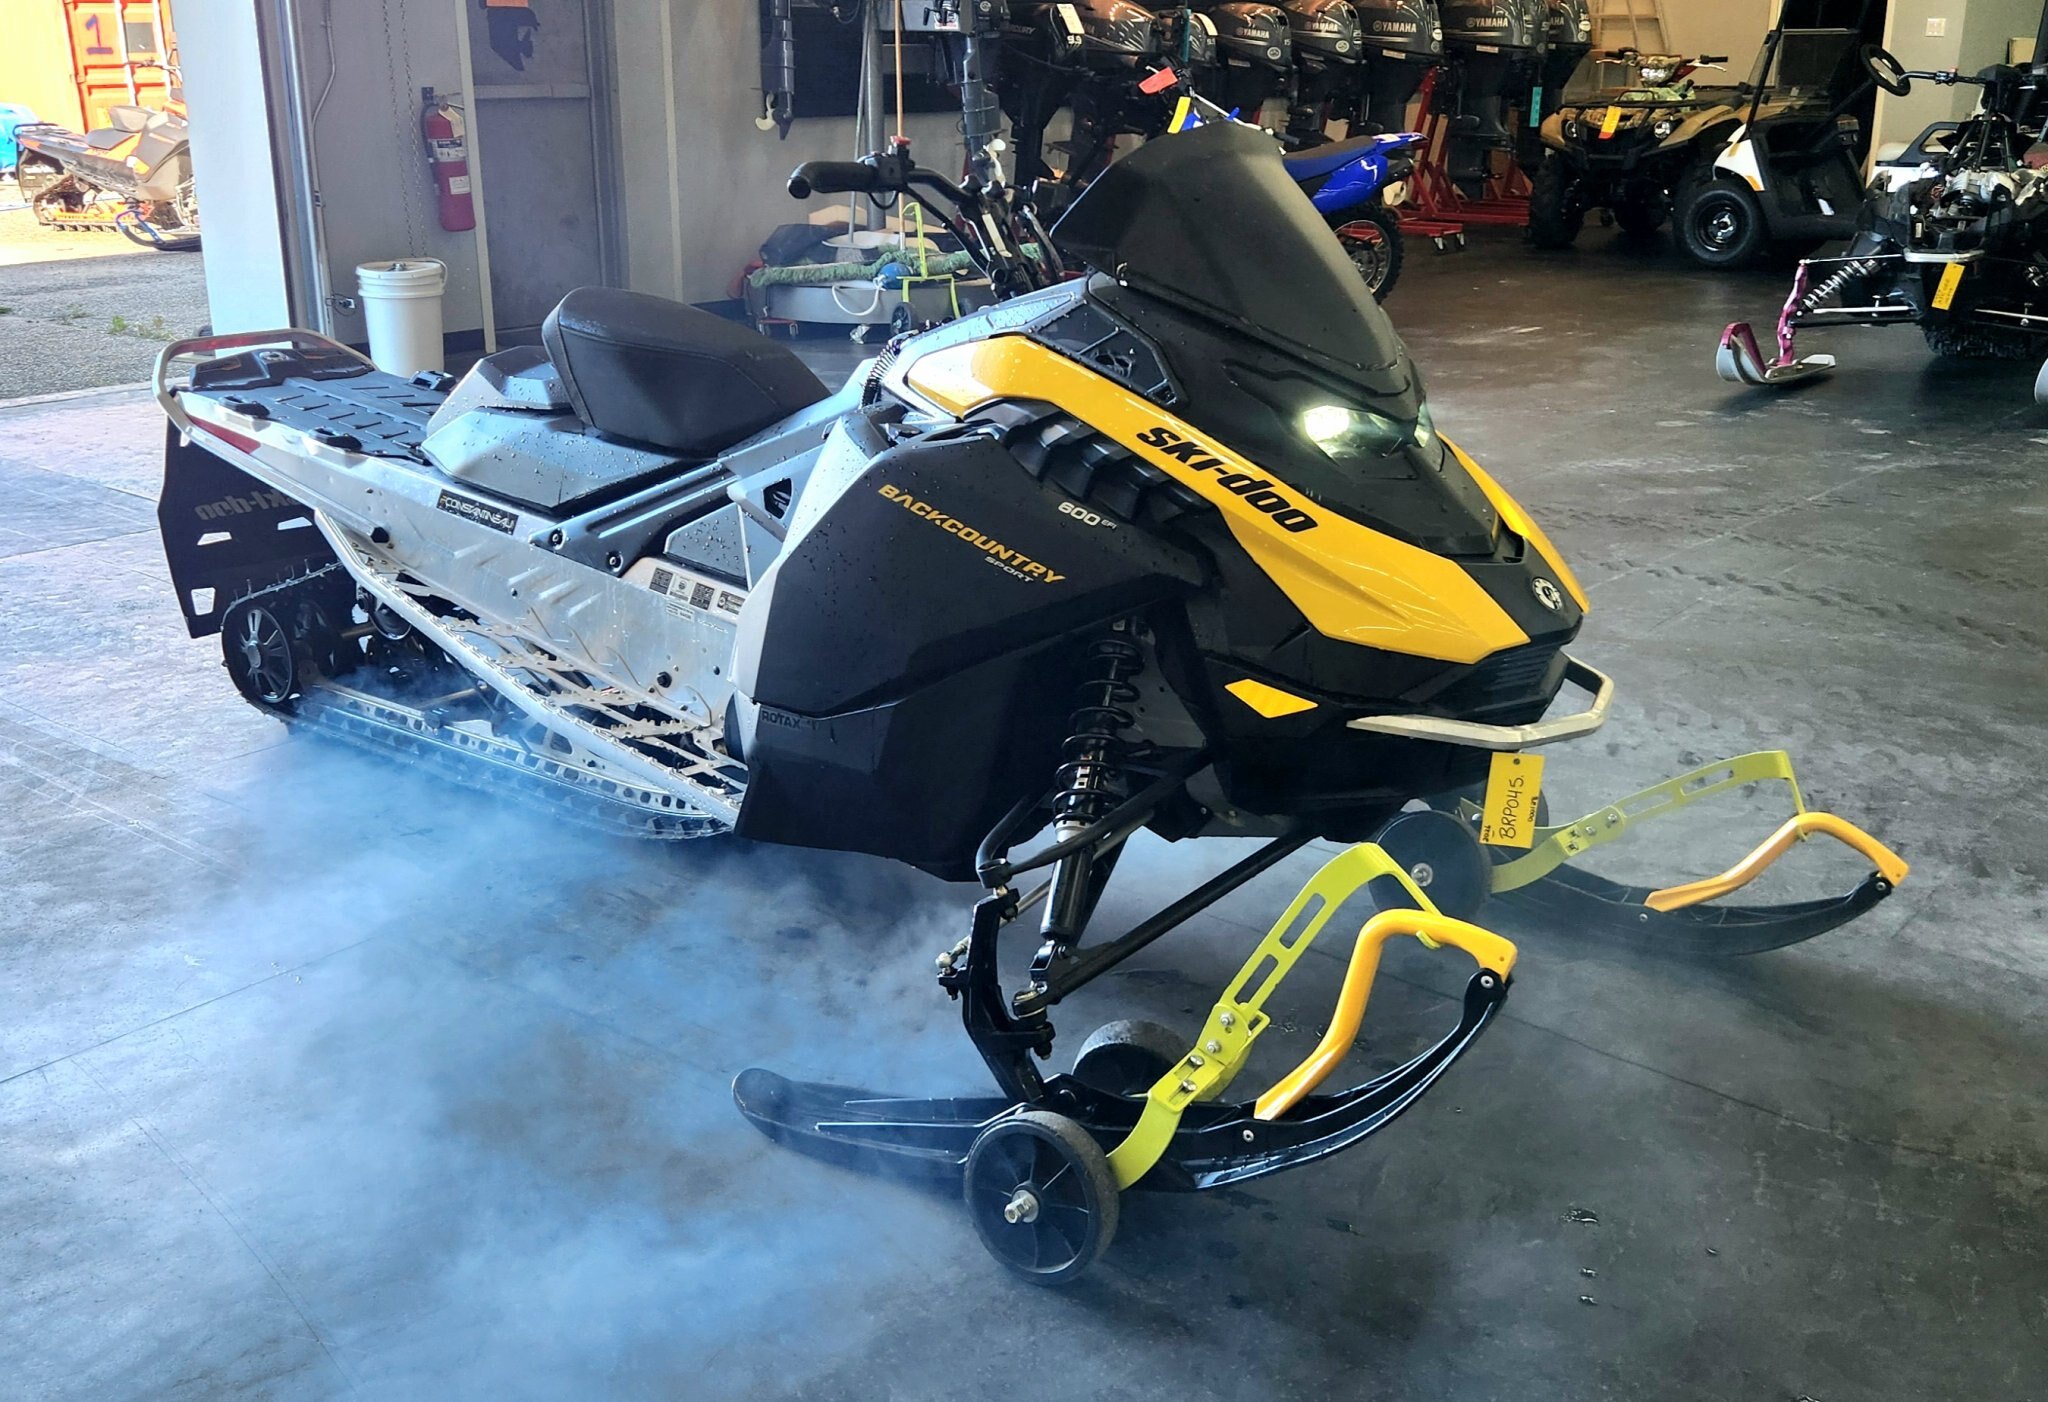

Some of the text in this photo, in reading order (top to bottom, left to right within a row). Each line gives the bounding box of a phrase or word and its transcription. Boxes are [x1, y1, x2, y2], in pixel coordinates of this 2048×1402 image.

[1243, 28, 1270, 39] YAMAHA
[1312, 21, 1338, 32] YAMAHA
[1381, 21, 1417, 33] YAMAHA
[1474, 17, 1509, 28] YAMAHA
[86, 14, 114, 55] 1
[1136, 427, 1319, 533] SKI-doo
[1057, 501, 1101, 526] 600
[878, 484, 1066, 584] BACKCOUNTRY
[984, 556, 1036, 583] SPORT
[761, 710, 801, 730] ROTAX
